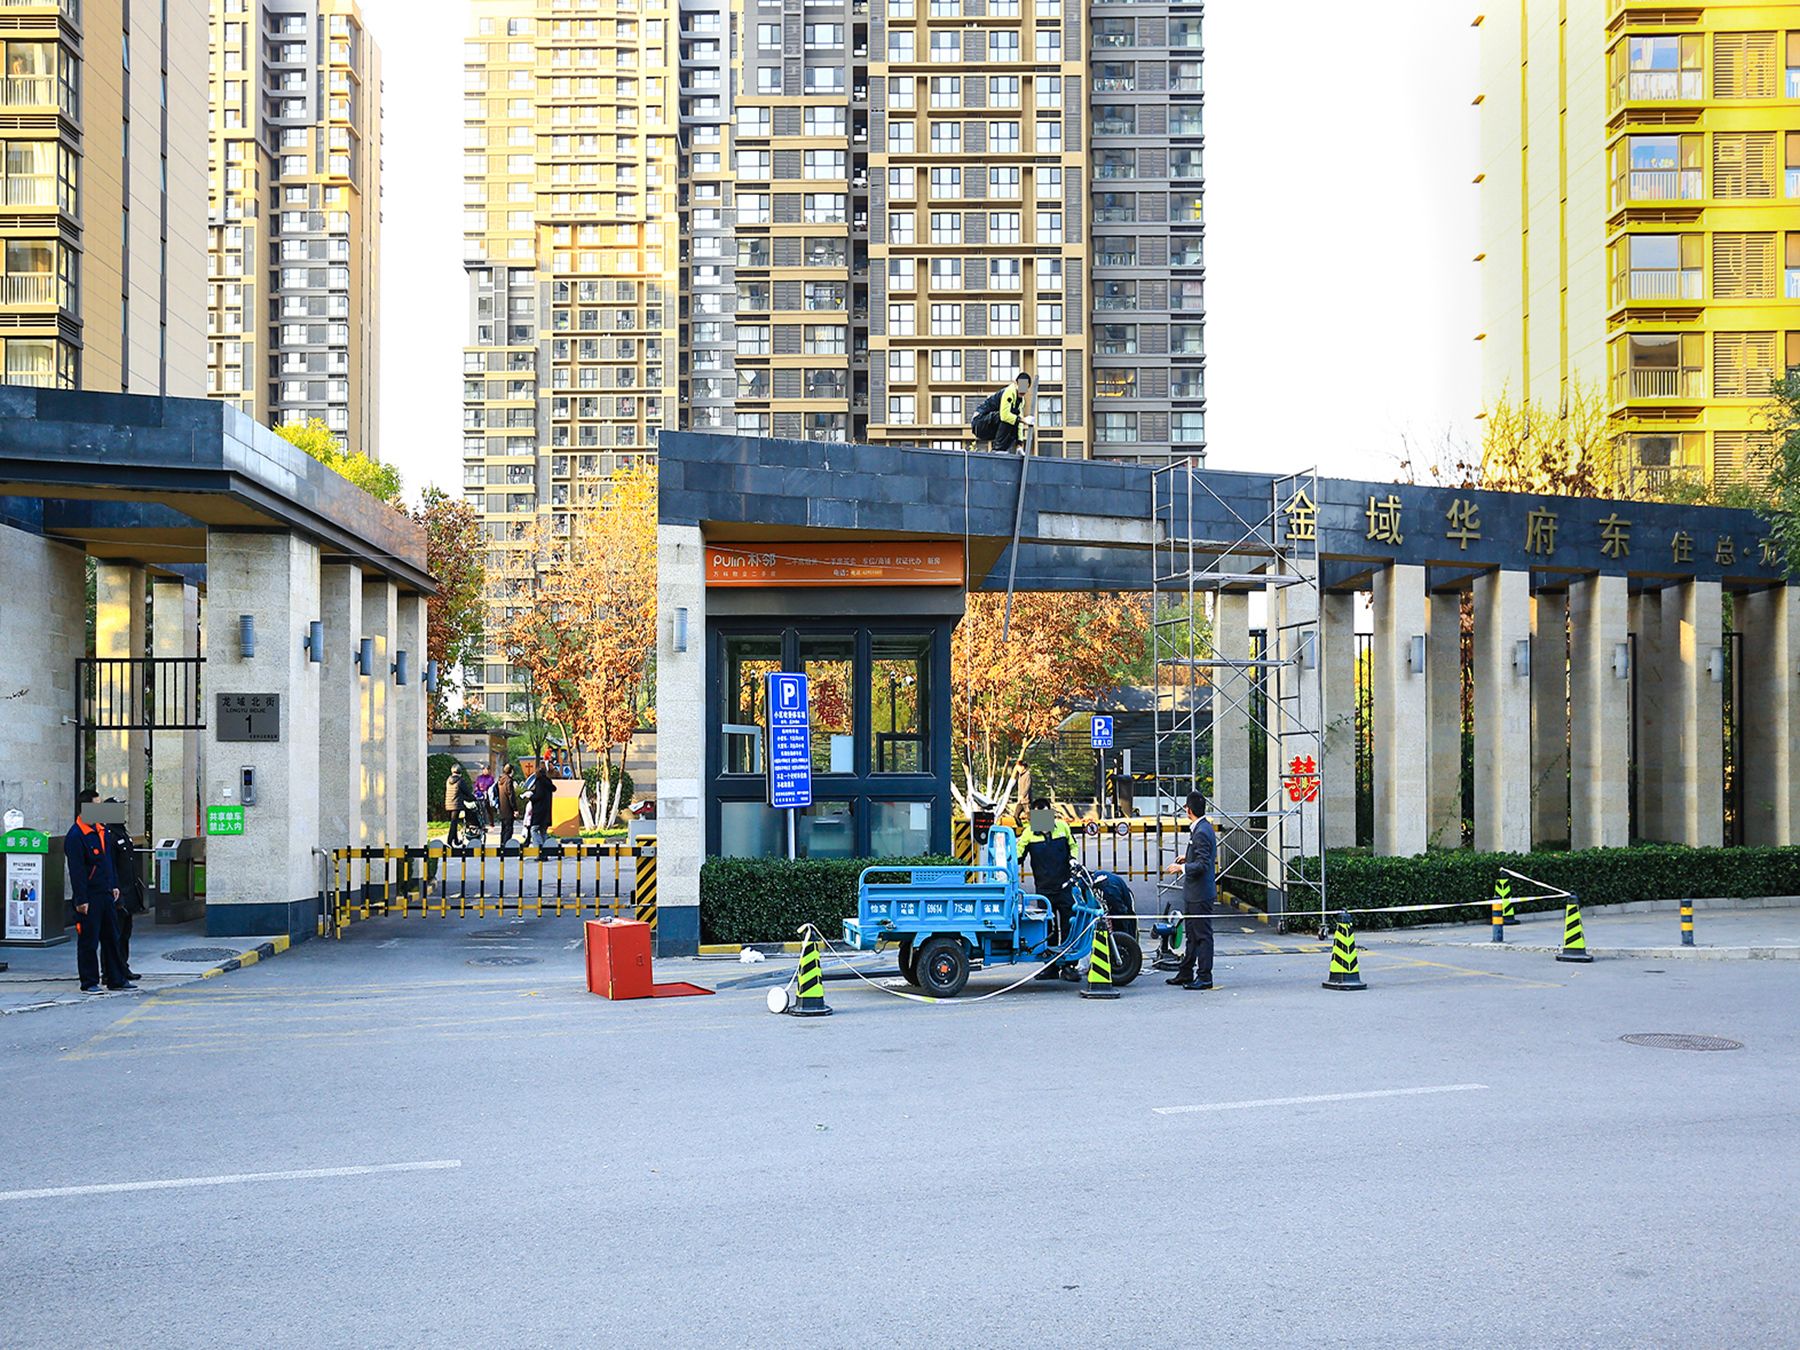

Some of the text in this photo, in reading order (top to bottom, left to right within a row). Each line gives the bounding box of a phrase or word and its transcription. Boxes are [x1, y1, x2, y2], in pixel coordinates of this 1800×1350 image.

[1284, 489, 1633, 561] 金域华府东
[748, 553, 777, 568] 朴邻
[783, 682, 796, 706] P
[222, 696, 275, 707] 龙域北街
[245, 714, 252, 734] 1
[209, 812, 242, 821] 共享单车
[209, 822, 242, 831] 禁止入内
[6, 837, 41, 848] 服务台
[870, 904, 887, 913] 怡宝
